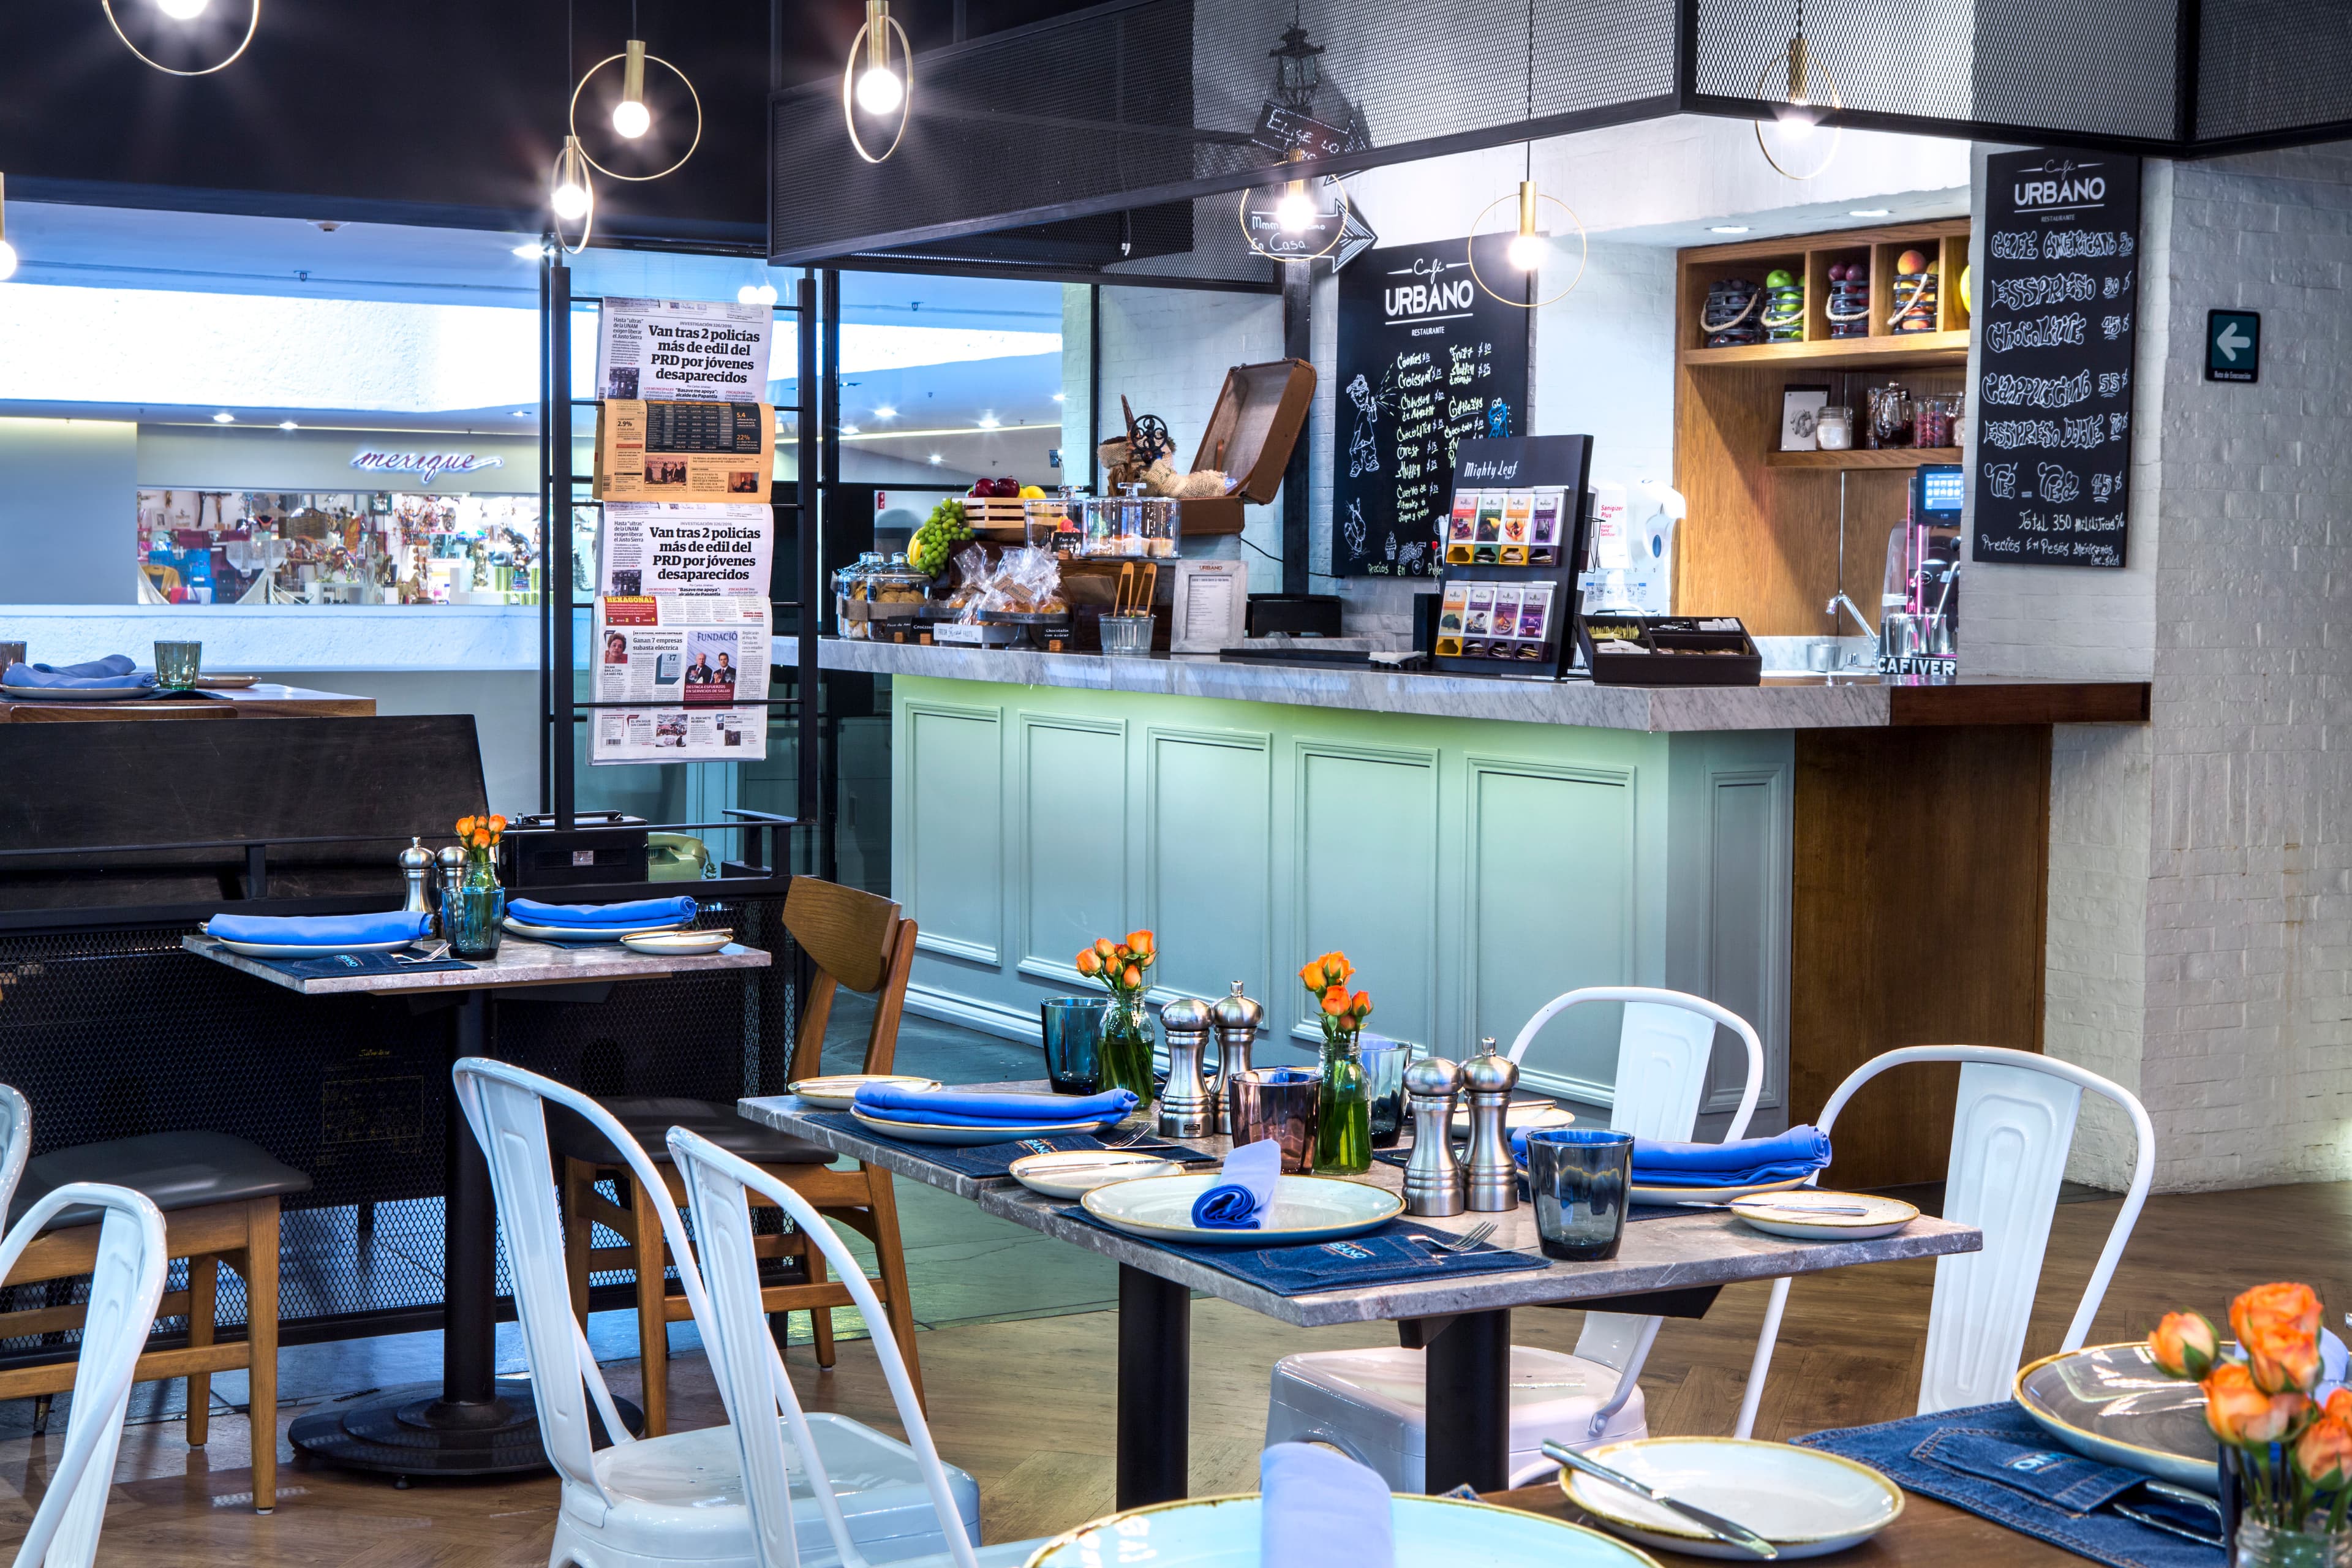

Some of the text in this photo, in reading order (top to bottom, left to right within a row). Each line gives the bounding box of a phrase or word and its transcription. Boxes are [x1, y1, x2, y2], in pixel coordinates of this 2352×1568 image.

[2015, 177, 2106, 206] URBANO
[1414, 258, 1444, 285] Café
[1385, 279, 1474, 317] URBANO
[649, 325, 760, 342] Van tras 2 policías
[1411, 326, 1444, 336] RESTAURANTE
[657, 340, 750, 356] más de edil del
[650, 353, 754, 370] PRD por jóvenes
[655, 368, 747, 383] desaparecidos
[352, 451, 502, 483] mexique
[1464, 460, 1518, 480] Mighty Leaf
[2052, 514, 2071, 531] 350
[649, 527, 761, 541] Van tras 2 policías
[659, 541, 752, 552] más de edil del
[652, 555, 756, 568] PRD por jóvenes
[658, 568, 749, 582] desaparecidos
[697, 631, 737, 641] FUNDACIÓ
[1878, 657, 1956, 676] CAFIVER
